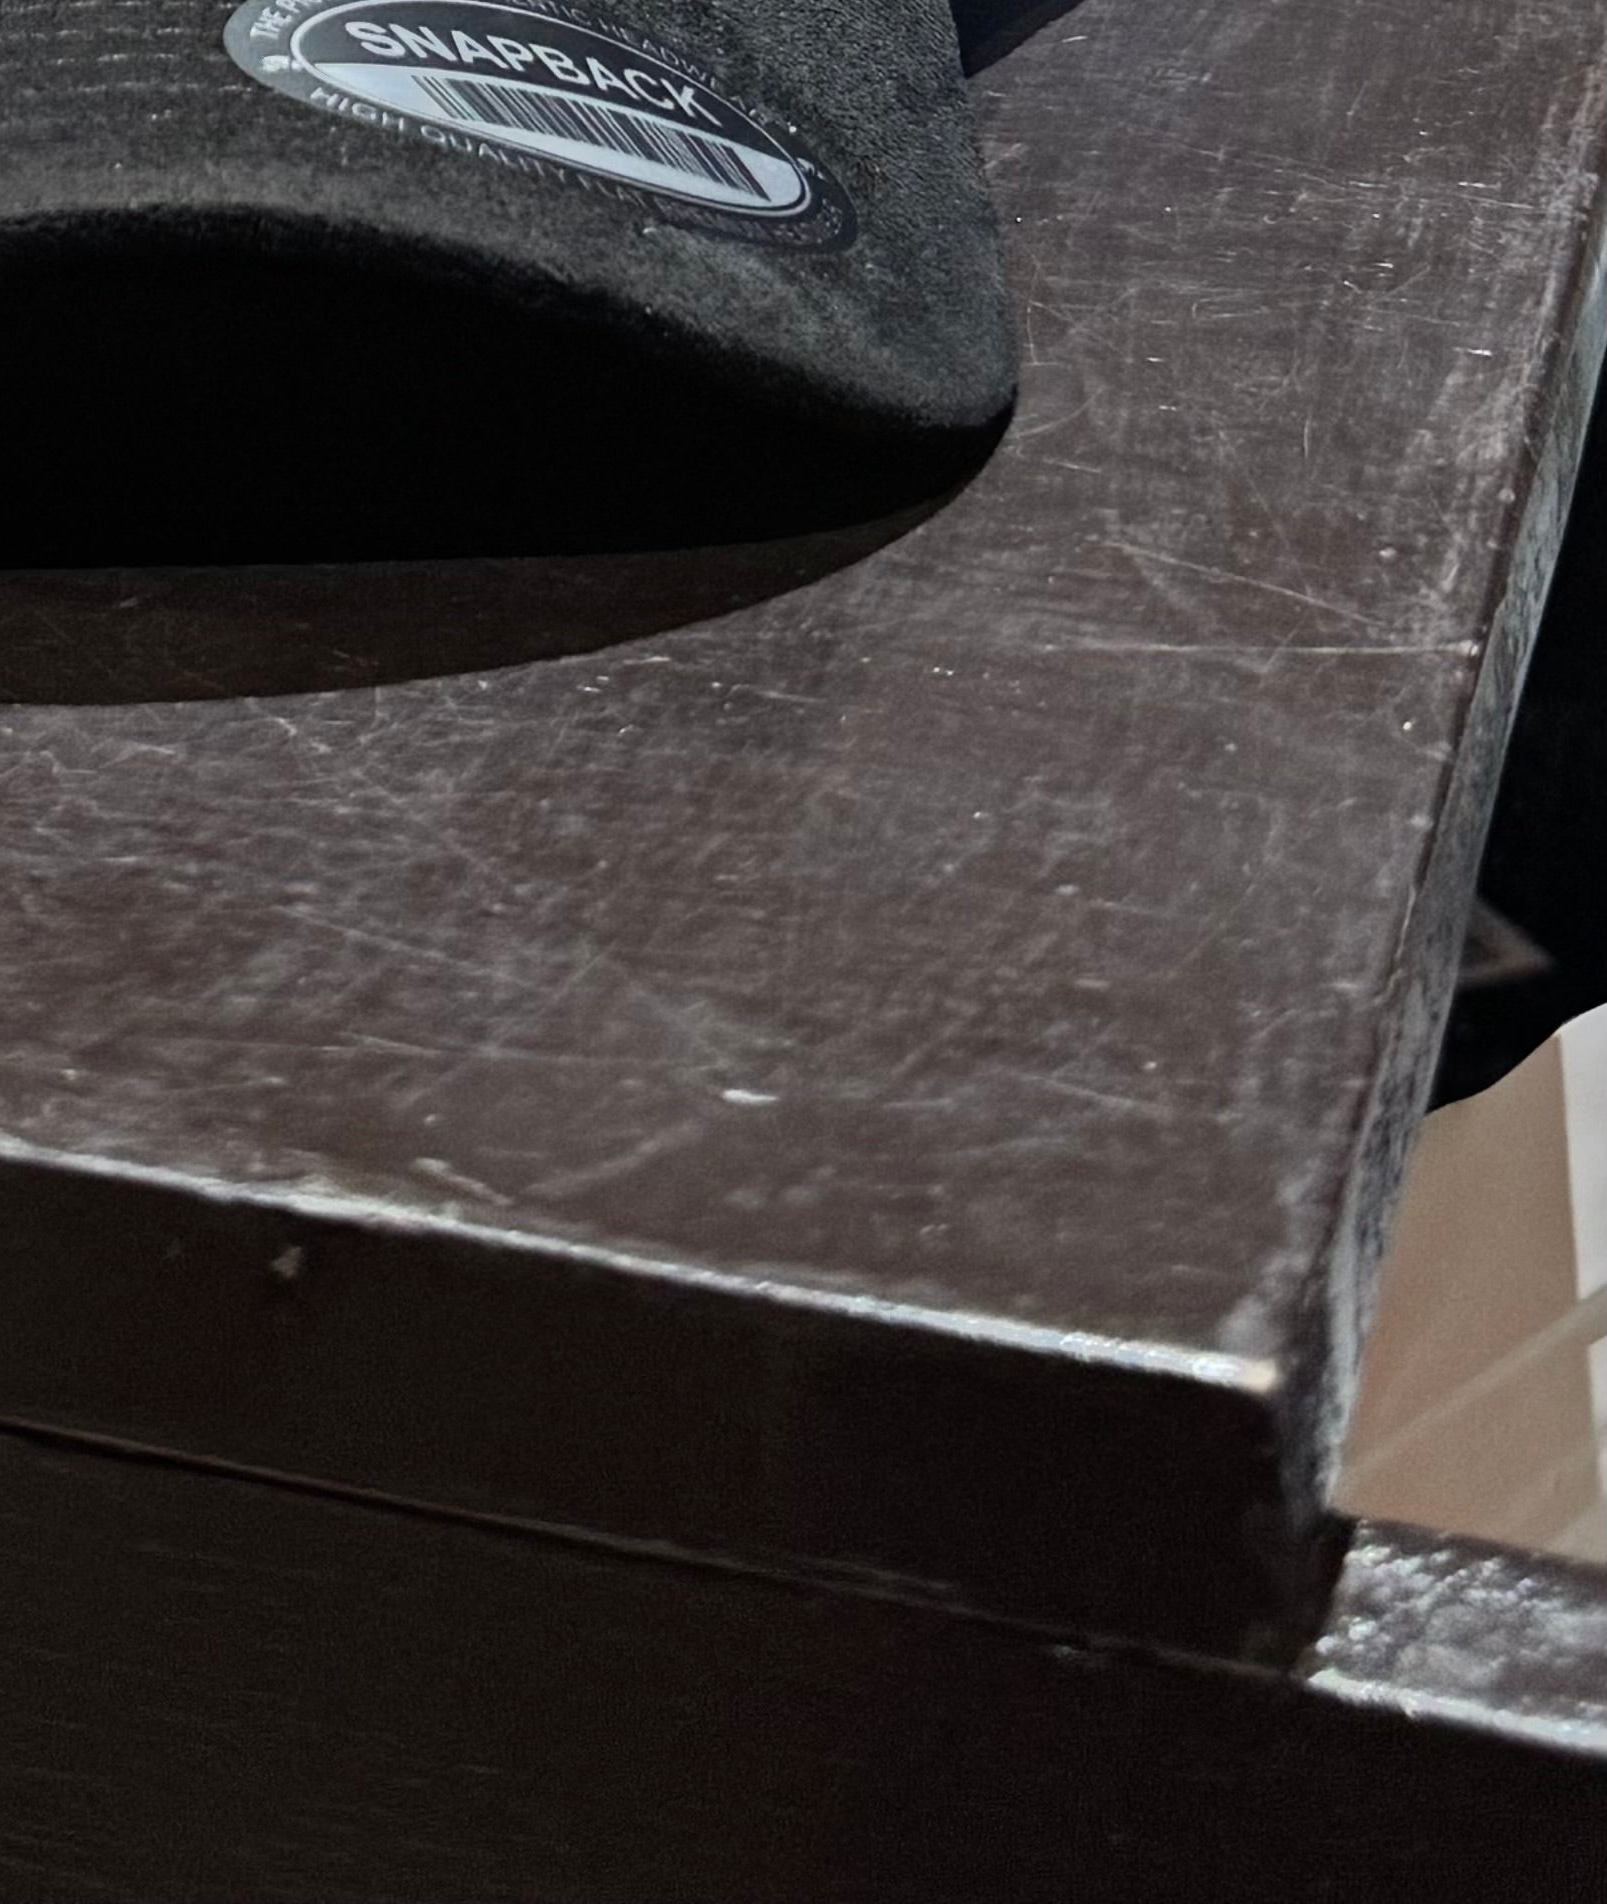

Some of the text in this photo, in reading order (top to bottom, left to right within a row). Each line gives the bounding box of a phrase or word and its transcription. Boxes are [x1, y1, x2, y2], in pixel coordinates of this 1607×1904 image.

[249, 6, 293, 40] THE
[344, 20, 723, 129] SNAPBACK
[309, 86, 405, 132] HIGH
[420, 124, 568, 186] QUALITY
